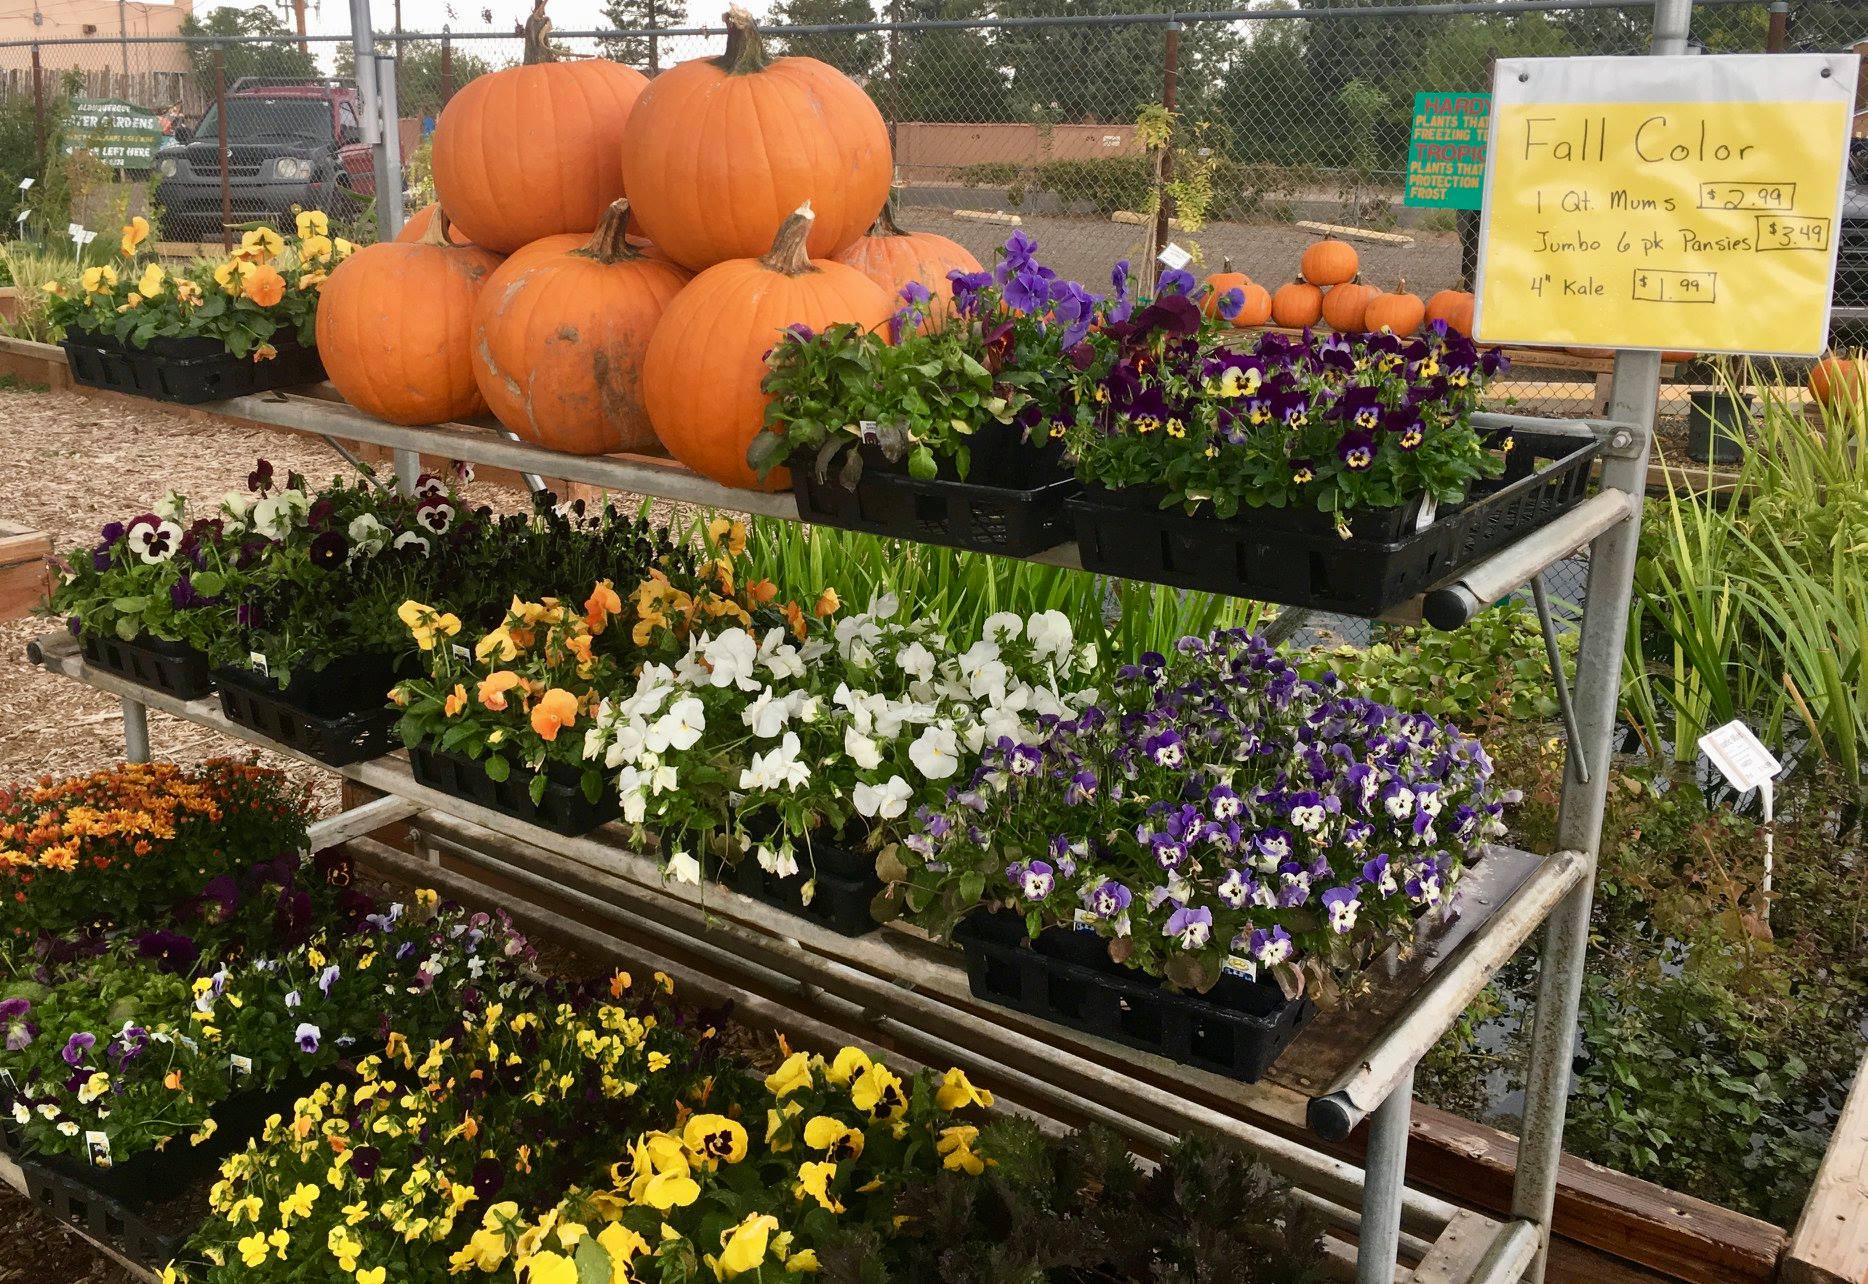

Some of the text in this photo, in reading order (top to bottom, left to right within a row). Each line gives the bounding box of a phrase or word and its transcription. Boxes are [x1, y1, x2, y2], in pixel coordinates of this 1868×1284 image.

[1415, 115, 1458, 128] PLANTS
[1414, 128, 1471, 141] FREEZING
[1525, 116, 1754, 163] Fall Color
[102, 146, 125, 157] LEFT
[126, 146, 151, 158] HERE
[1410, 161, 1454, 174] PLANTS
[1409, 174, 1480, 188] PROTECTION
[1610, 189, 1676, 213] Mums
[1533, 222, 1822, 257] Jumbo 6 pk Pansies $3.49
[1563, 276, 1604, 297] Kale
